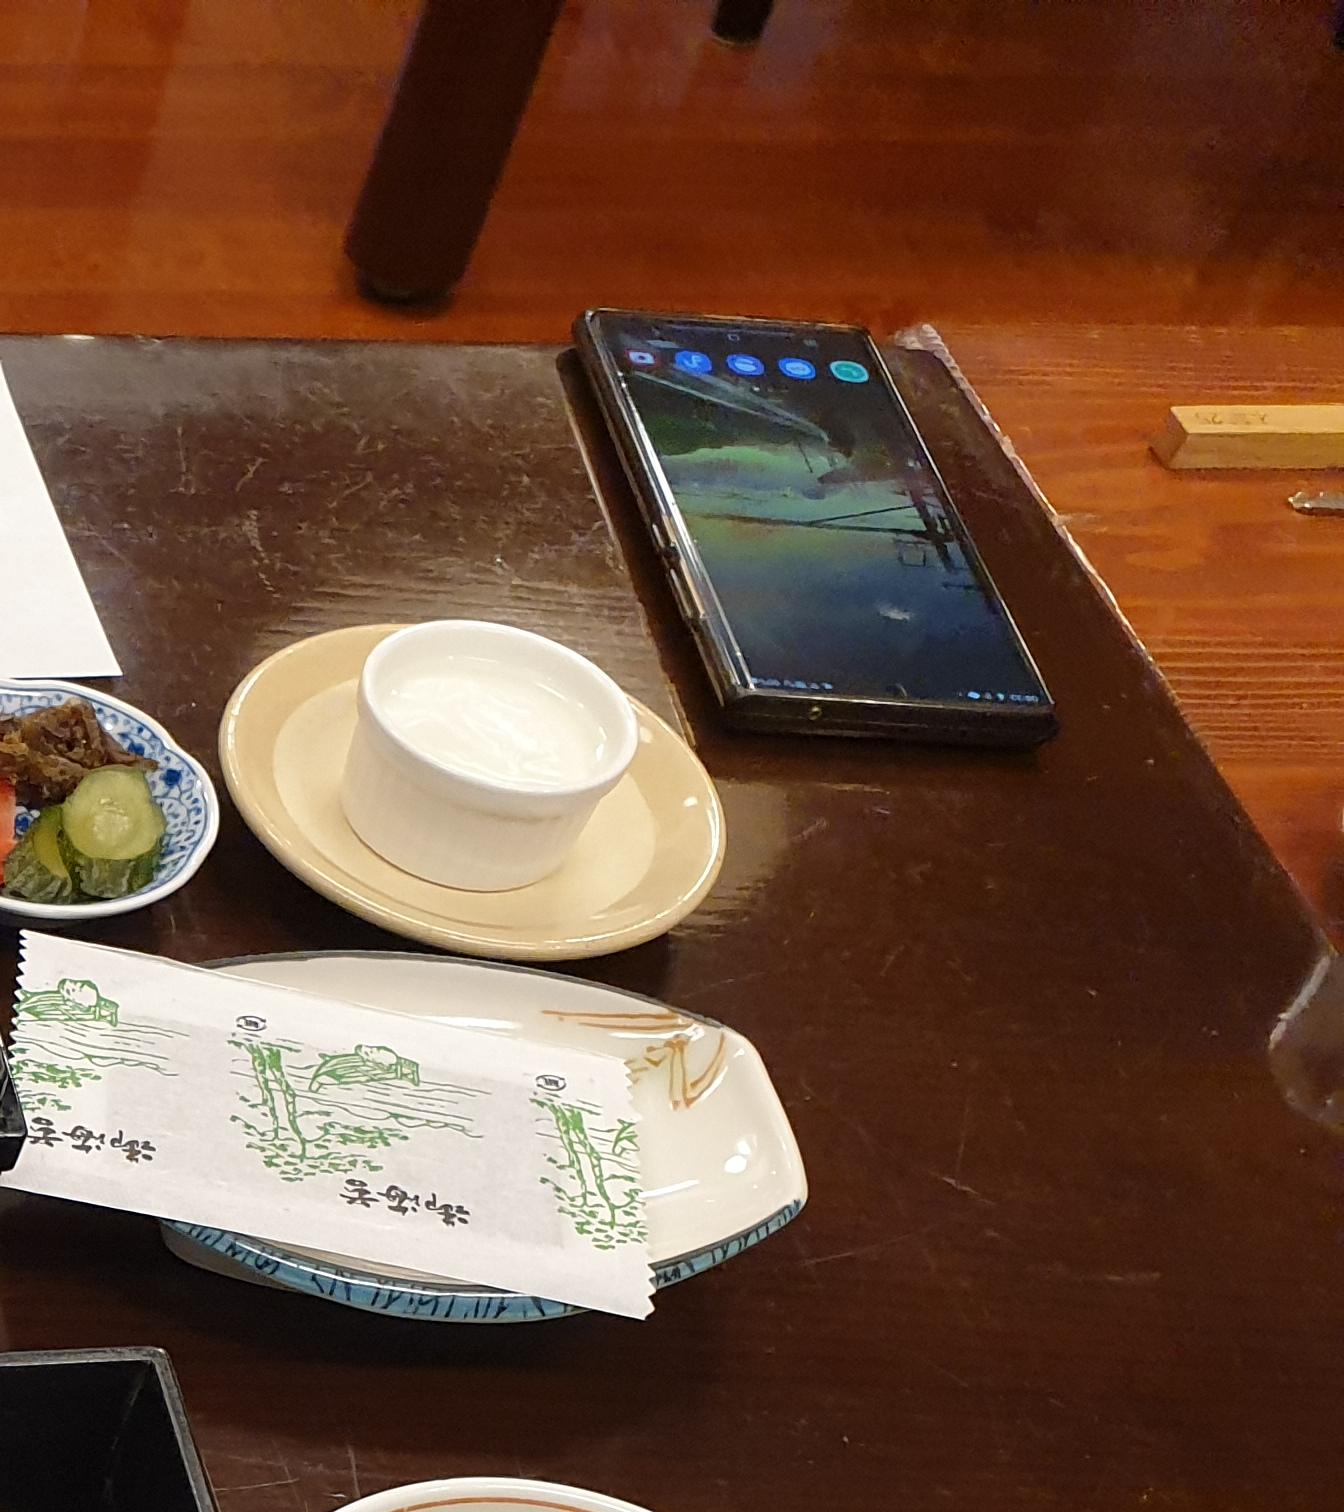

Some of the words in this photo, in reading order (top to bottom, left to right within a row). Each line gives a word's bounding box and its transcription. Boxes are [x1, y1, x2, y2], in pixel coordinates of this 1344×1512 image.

[27, 1116, 157, 1163] 御海苔
[339, 1178, 471, 1227] 御海苔
